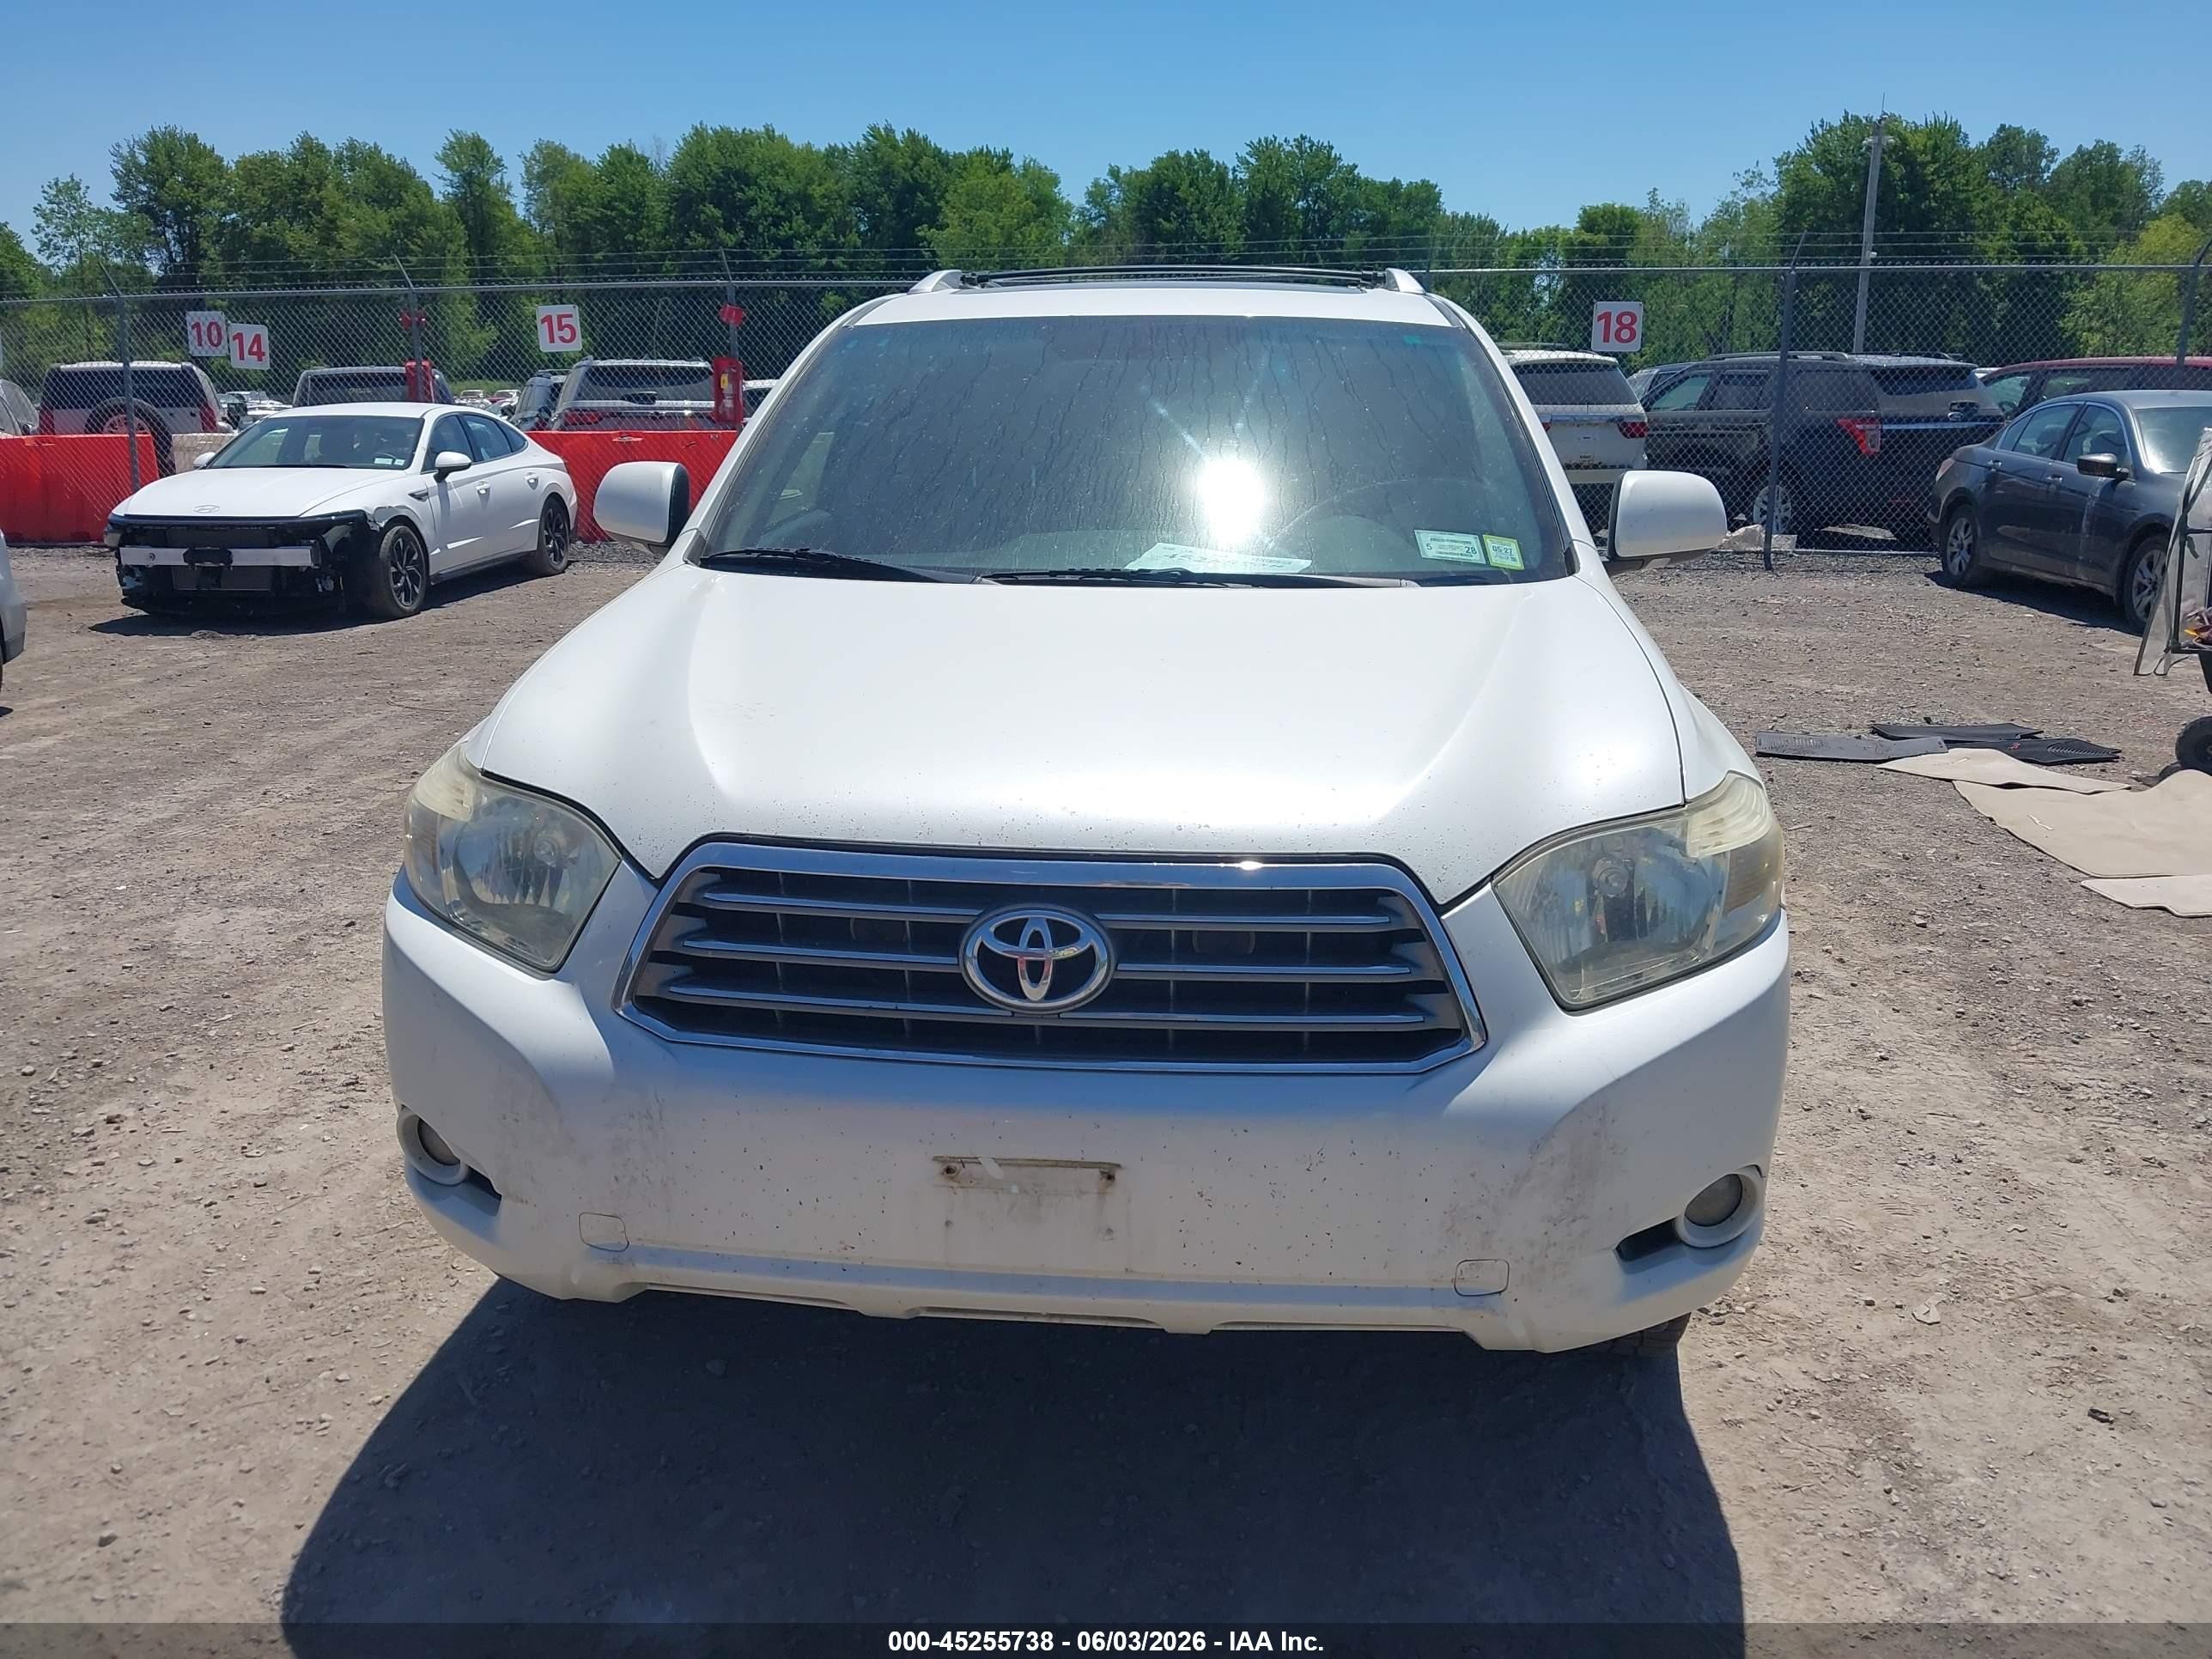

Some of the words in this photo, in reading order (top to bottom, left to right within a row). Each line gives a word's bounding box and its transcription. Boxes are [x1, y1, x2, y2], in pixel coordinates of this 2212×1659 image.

[191, 321, 222, 348] 10
[540, 313, 577, 344] 15
[1596, 311, 1638, 343] 18
[232, 331, 266, 362] 14
[1464, 545, 1478, 555] 28
